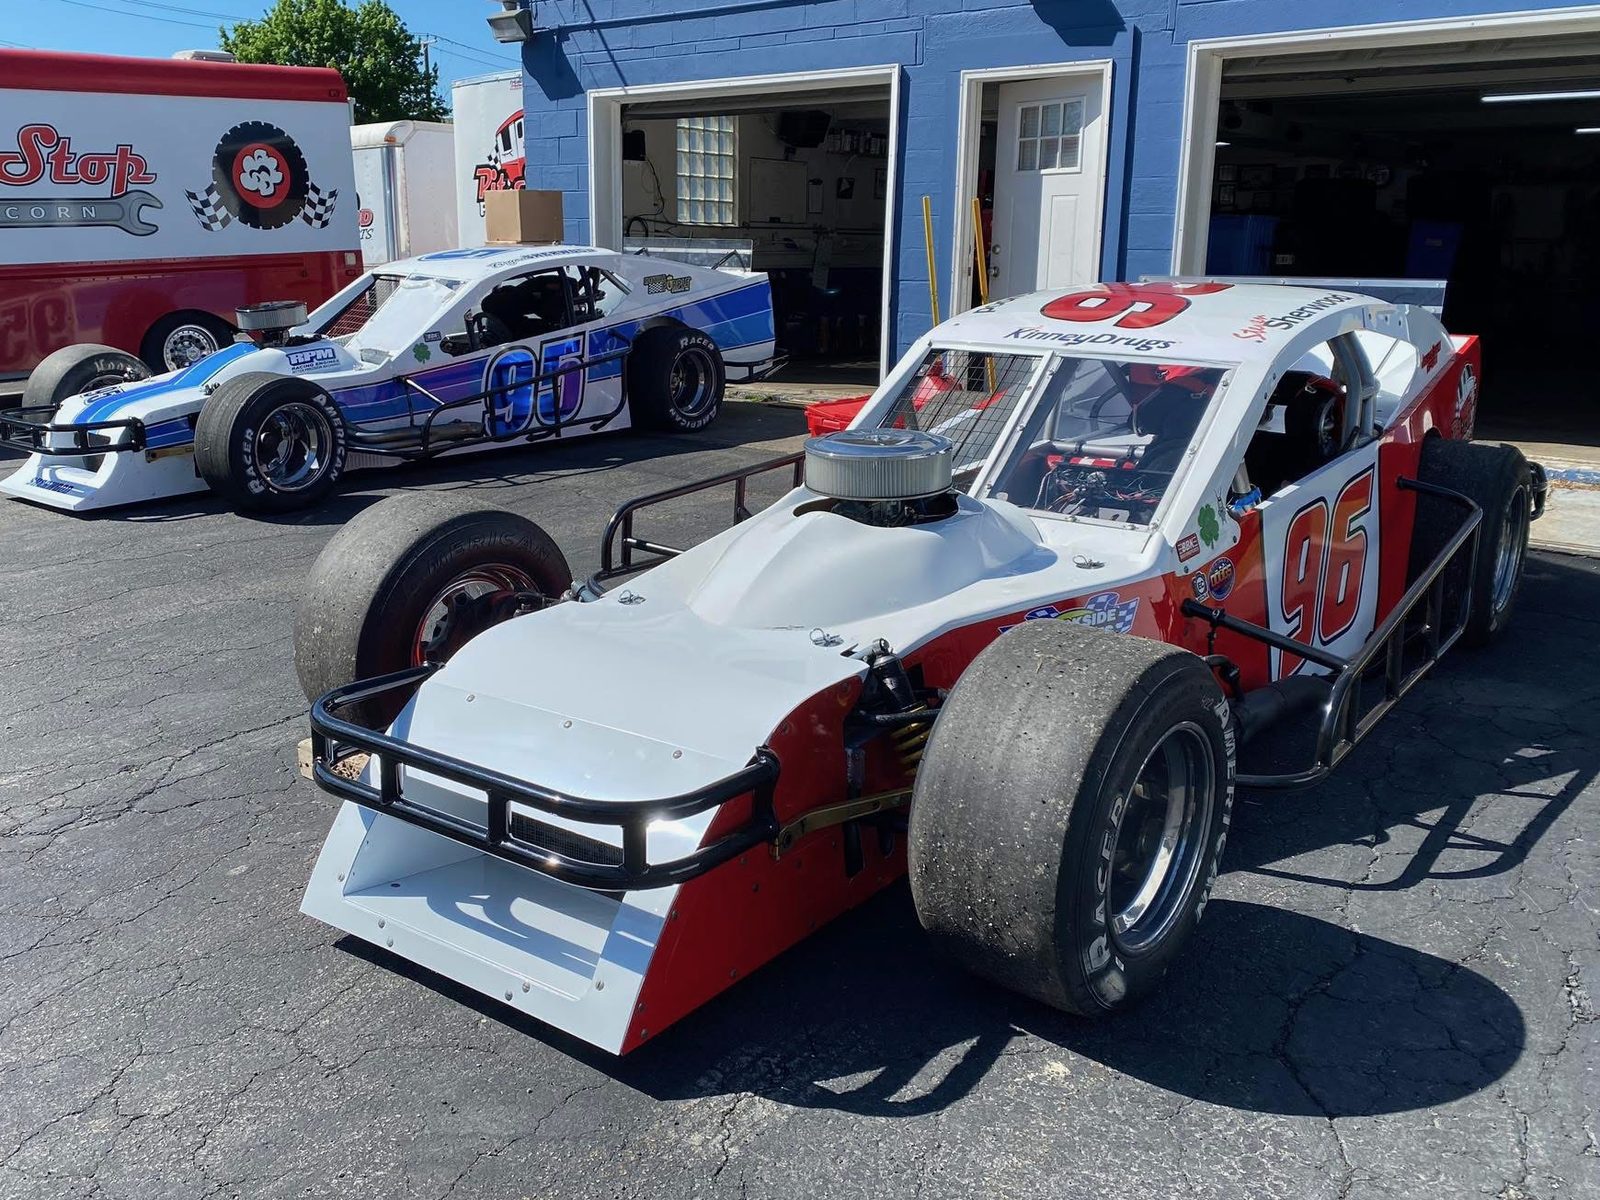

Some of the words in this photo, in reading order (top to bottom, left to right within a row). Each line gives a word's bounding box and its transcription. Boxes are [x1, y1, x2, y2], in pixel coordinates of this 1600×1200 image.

[0, 123, 157, 198] Stop
[287, 348, 335, 365] RPM
[680, 337, 714, 351] RACER
[482, 331, 586, 437] 95
[669, 405, 717, 428] AMERICAN
[242, 428, 265, 494] RACER
[313, 394, 346, 481] AMERICAN
[1279, 462, 1376, 680] 96
[1072, 609, 1117, 626] KSIDE
[1196, 696, 1236, 923] AMERICAN
[1085, 797, 1123, 975] RACER
